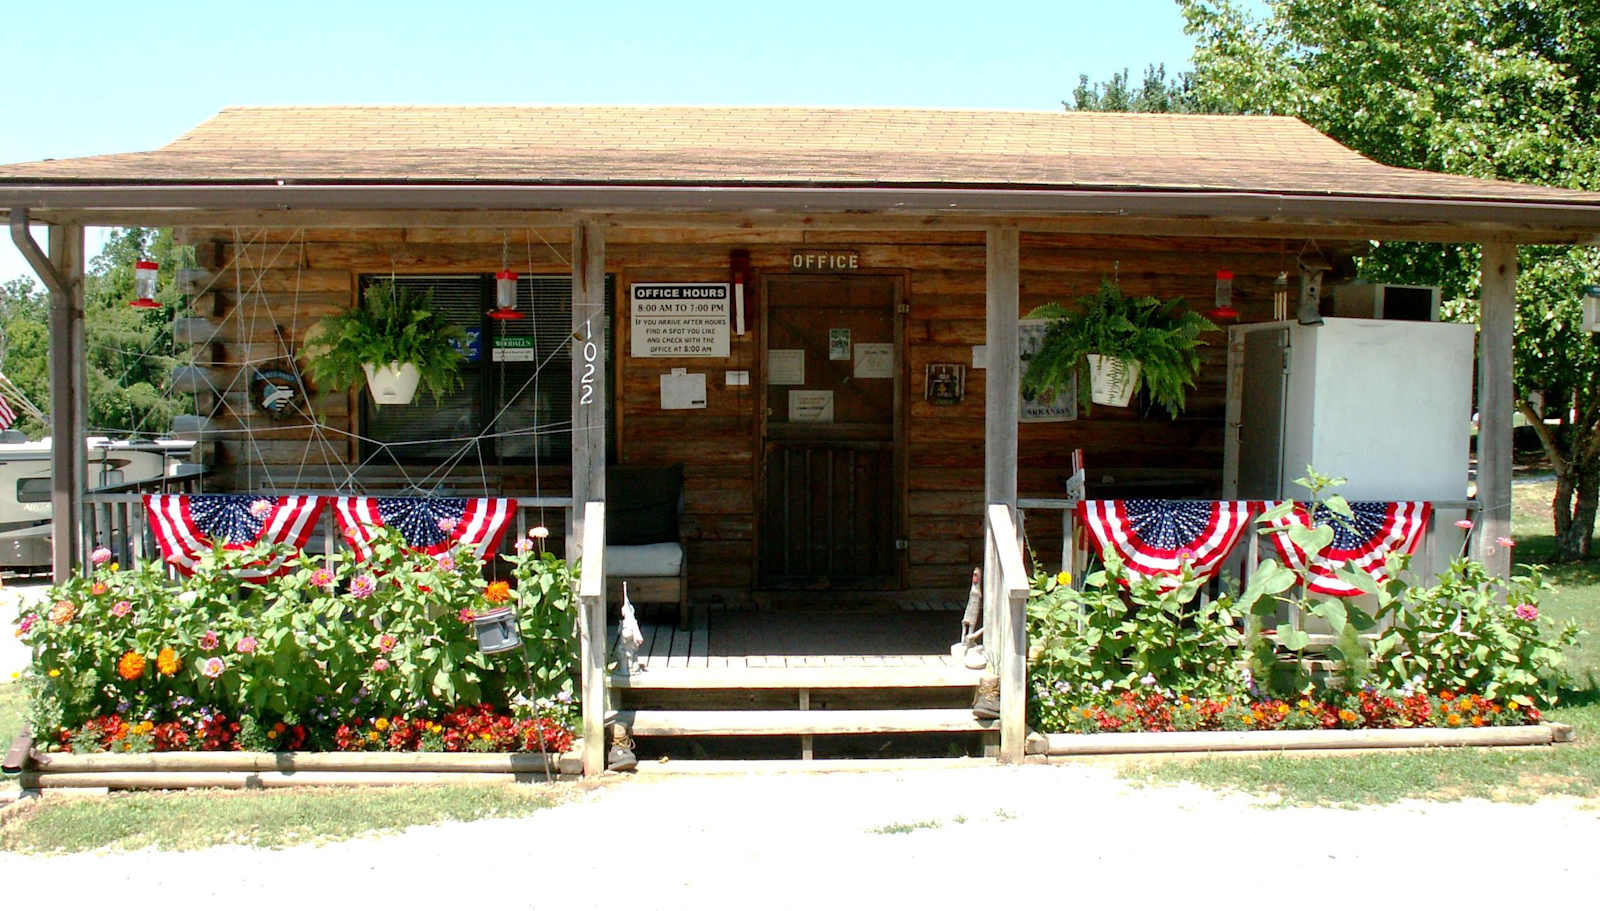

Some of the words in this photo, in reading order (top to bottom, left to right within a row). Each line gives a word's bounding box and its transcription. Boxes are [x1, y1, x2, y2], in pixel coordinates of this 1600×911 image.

[793, 255, 858, 269] OFFICE
[636, 288, 680, 298] OFFICE
[682, 288, 725, 298] HOURS
[637, 304, 657, 312] 8:00
[659, 304, 673, 312] AM
[675, 304, 687, 312] TO
[690, 304, 709, 312] 7:00
[711, 304, 724, 312] PM
[580, 319, 597, 405] 1022
